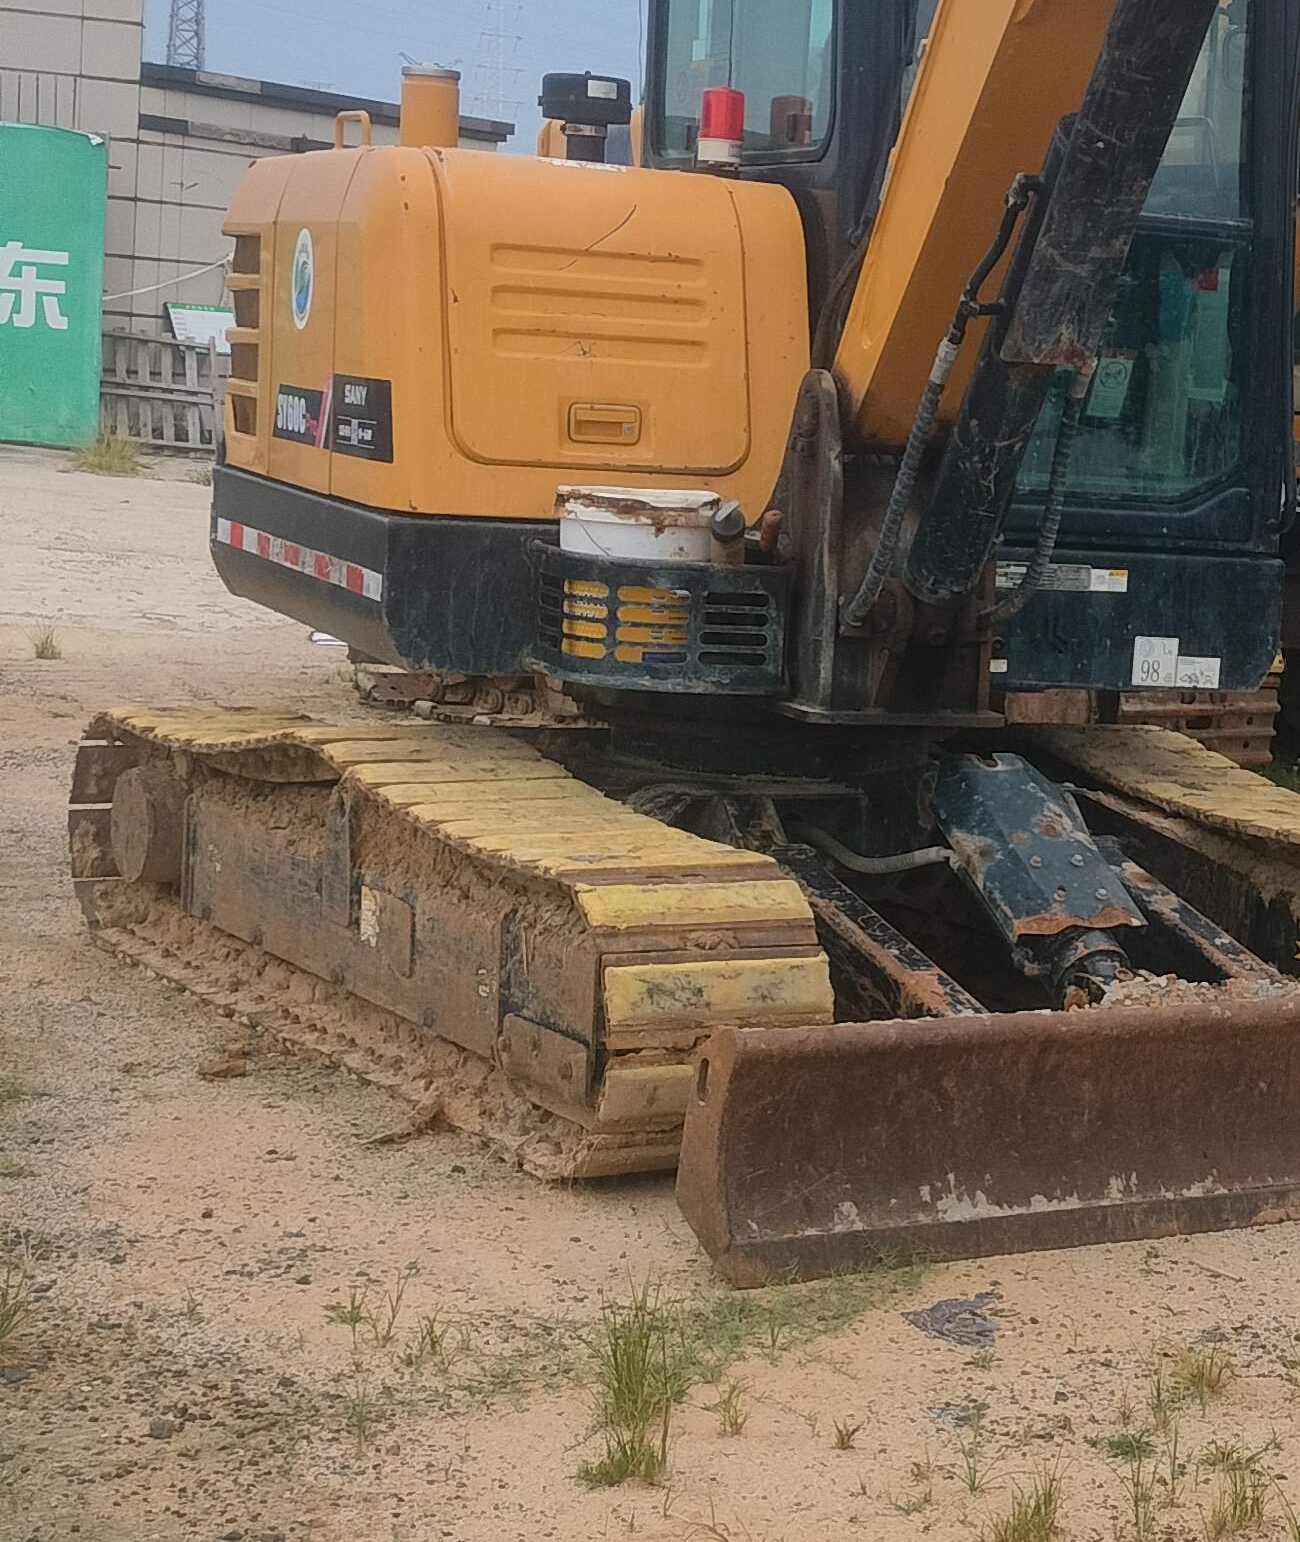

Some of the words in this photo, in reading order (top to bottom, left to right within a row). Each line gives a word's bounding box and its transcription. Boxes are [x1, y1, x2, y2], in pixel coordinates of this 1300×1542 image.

[0, 241, 69, 330] 东
[344, 384, 368, 406] SANY
[1140, 659, 1161, 683] 98
